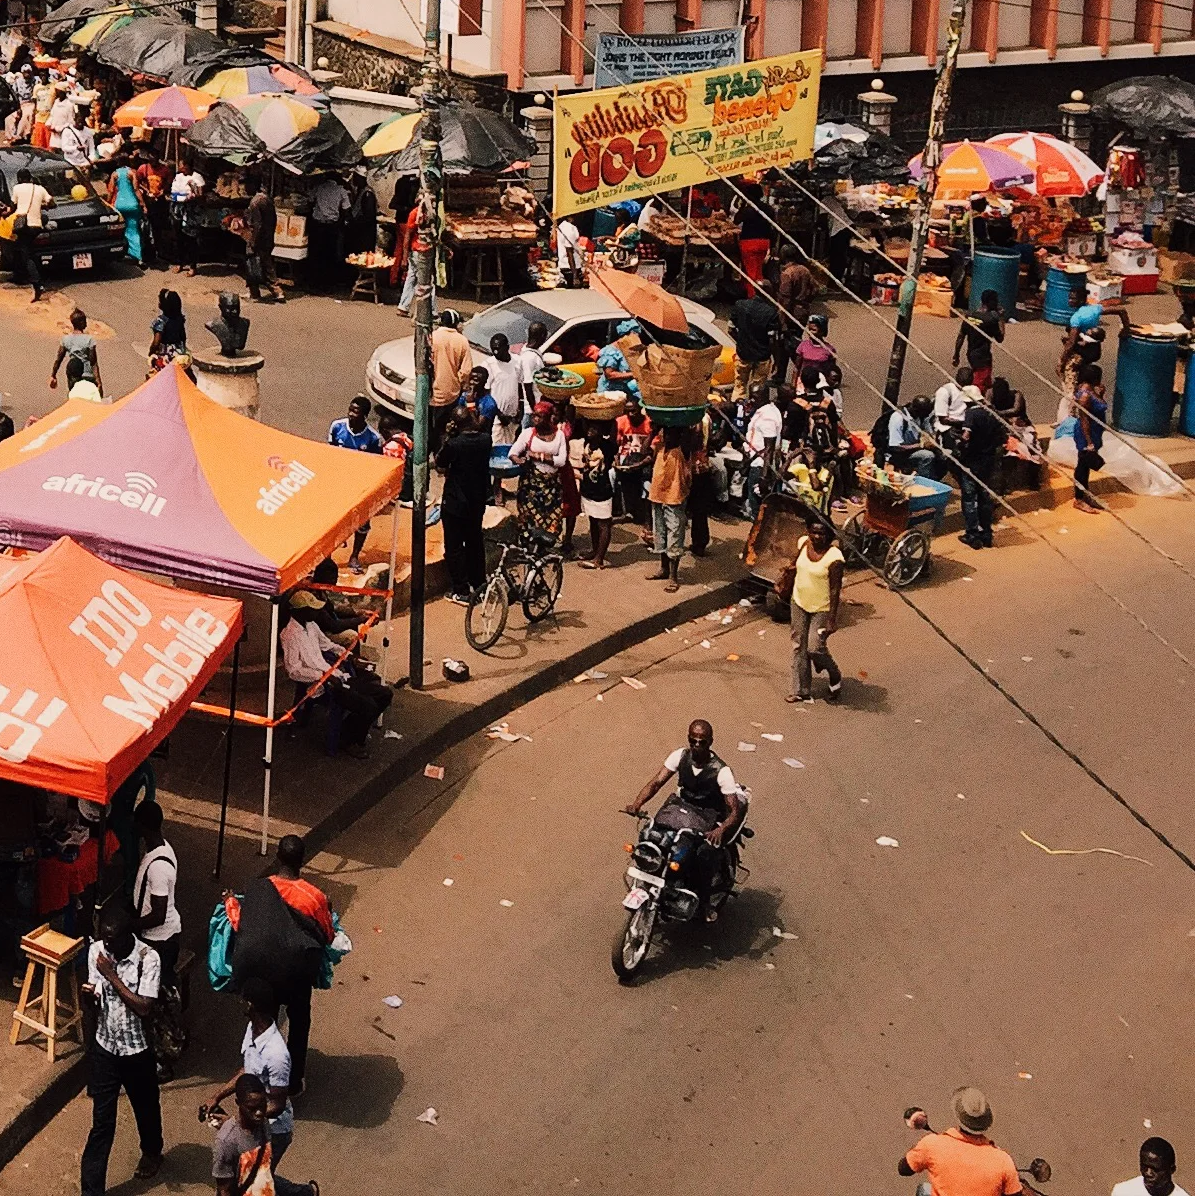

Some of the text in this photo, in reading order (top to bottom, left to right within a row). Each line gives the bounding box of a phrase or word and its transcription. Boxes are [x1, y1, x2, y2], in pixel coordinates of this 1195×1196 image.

[629, 52, 646, 62] THE
[42, 473, 167, 517] africell
[256, 459, 316, 516] africell
[69, 579, 153, 668] IDO
[102, 607, 230, 735] Mobile
